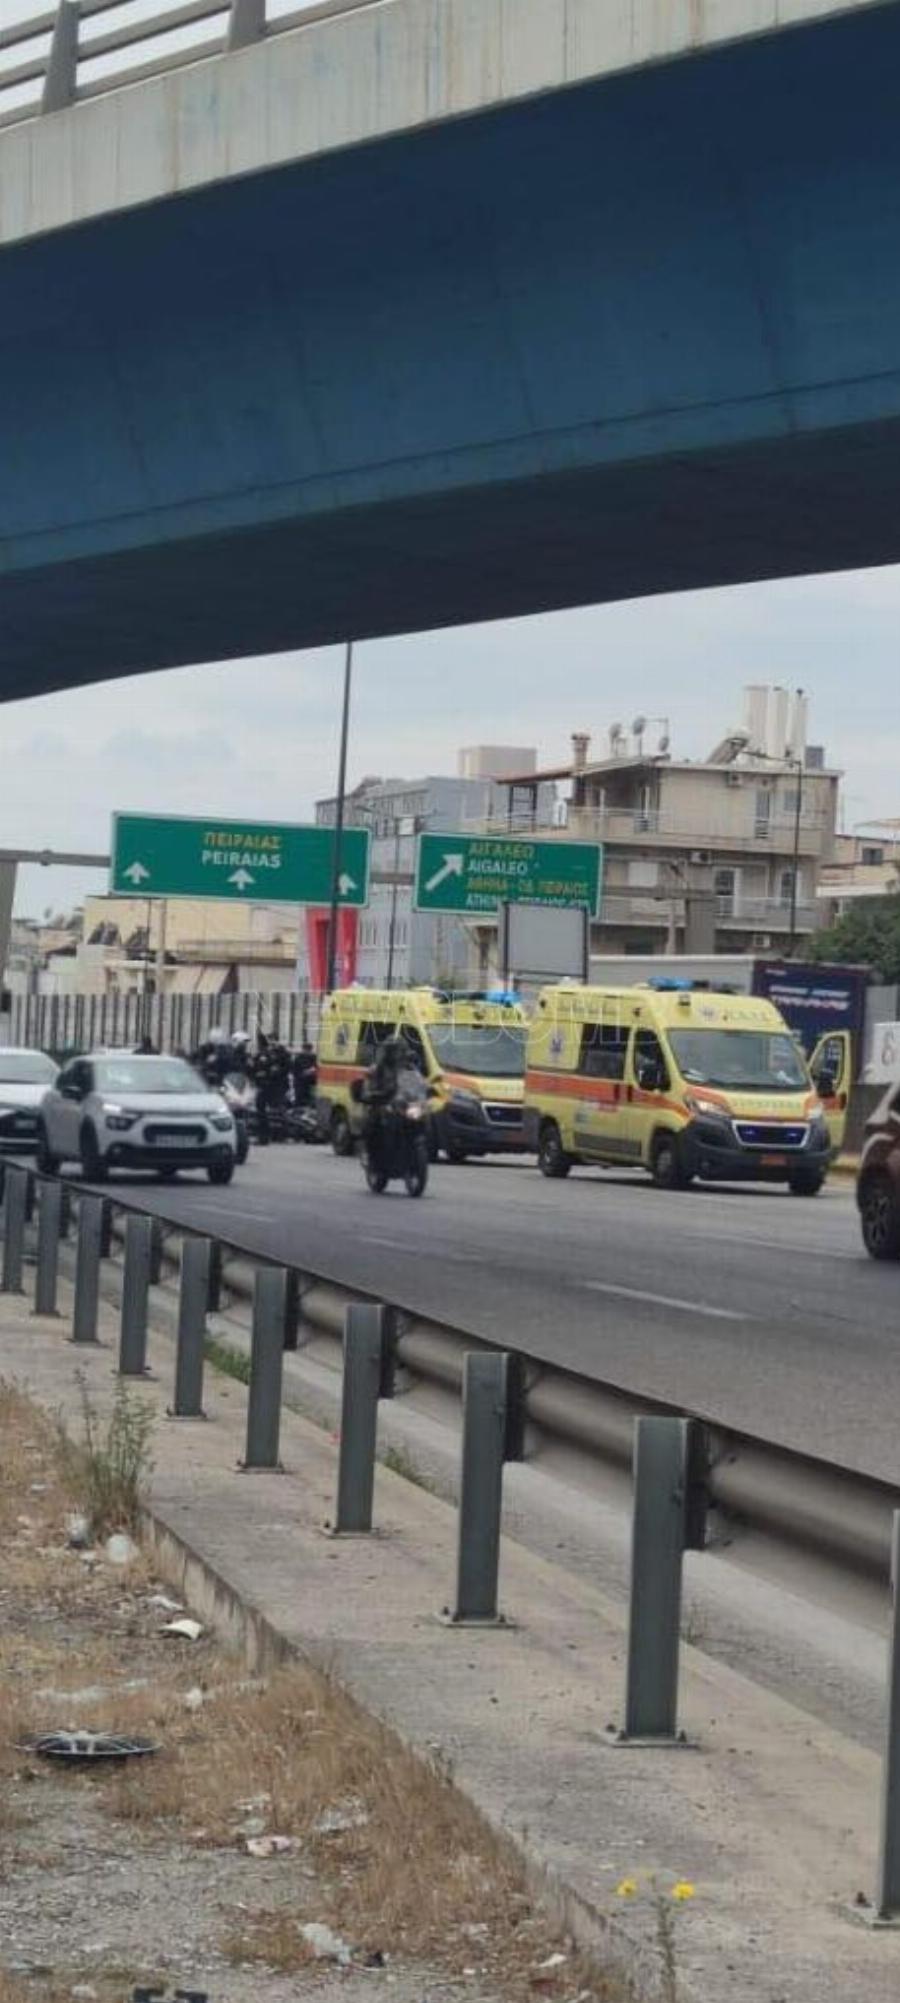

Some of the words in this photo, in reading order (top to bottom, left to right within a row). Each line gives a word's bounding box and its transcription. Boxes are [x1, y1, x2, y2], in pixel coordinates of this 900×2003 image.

[203, 831, 281, 849] ΠΕΙΡΑΙΑΣ
[202, 849, 281, 868] PEIRAIAS
[467, 859, 528, 876] AIGALEO
